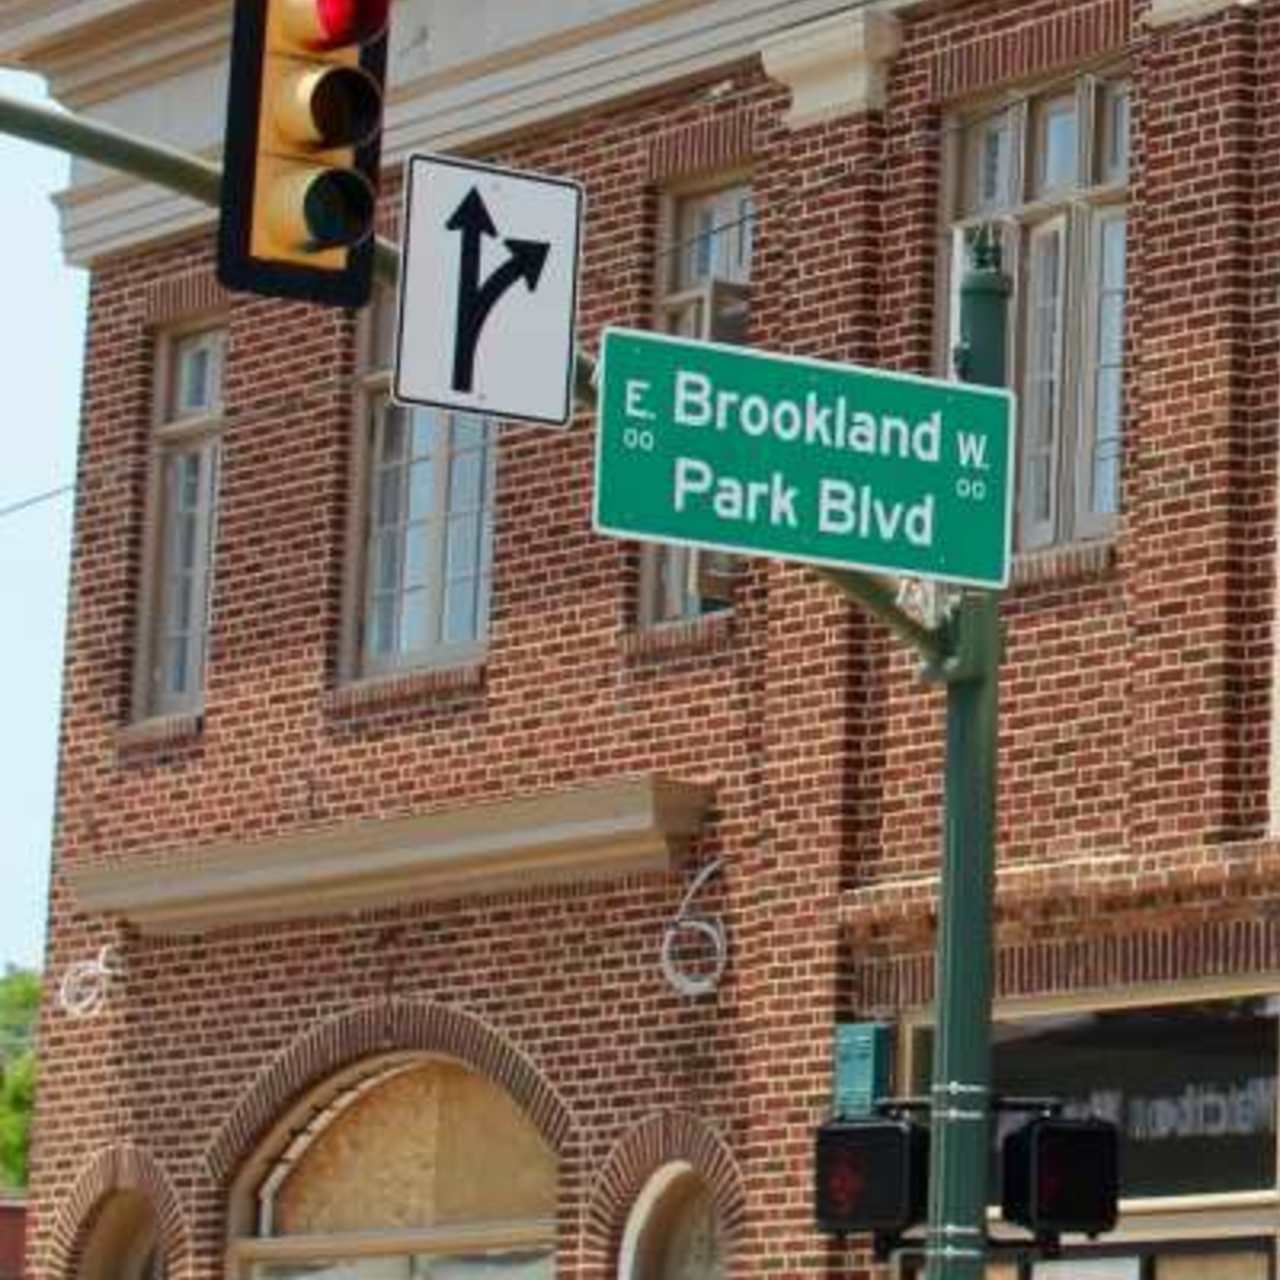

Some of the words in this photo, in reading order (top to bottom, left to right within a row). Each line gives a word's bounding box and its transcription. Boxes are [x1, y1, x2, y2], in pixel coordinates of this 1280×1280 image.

[673, 370, 942, 462] Brookland
[673, 457, 798, 528] Park
[818, 478, 935, 547] Blvd
